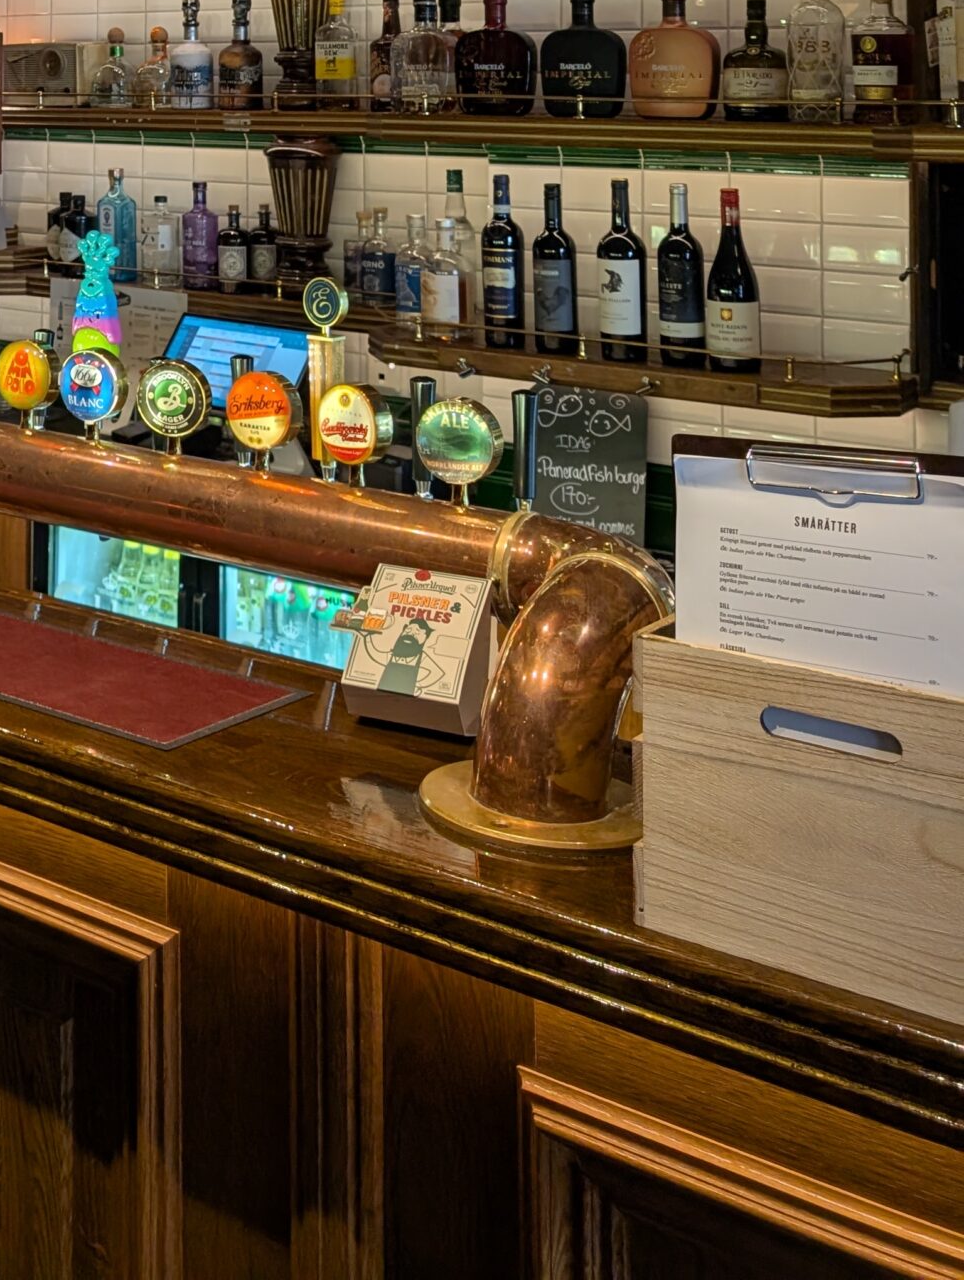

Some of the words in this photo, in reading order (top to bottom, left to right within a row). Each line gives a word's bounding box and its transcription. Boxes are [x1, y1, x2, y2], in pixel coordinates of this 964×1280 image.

[152, 372, 191, 392] BROOKLYN
[68, 394, 104, 410] BLANC
[229, 394, 285, 416] Eriksberg
[156, 412, 185, 423] LAGER
[440, 414, 470, 430] ALE
[555, 433, 592, 450] IDAG
[794, 516, 858, 535] SMÅRÄTTER
[388, 591, 451, 610] PILSNER
[450, 602, 462, 614] &
[391, 604, 453, 625] PICKLES
